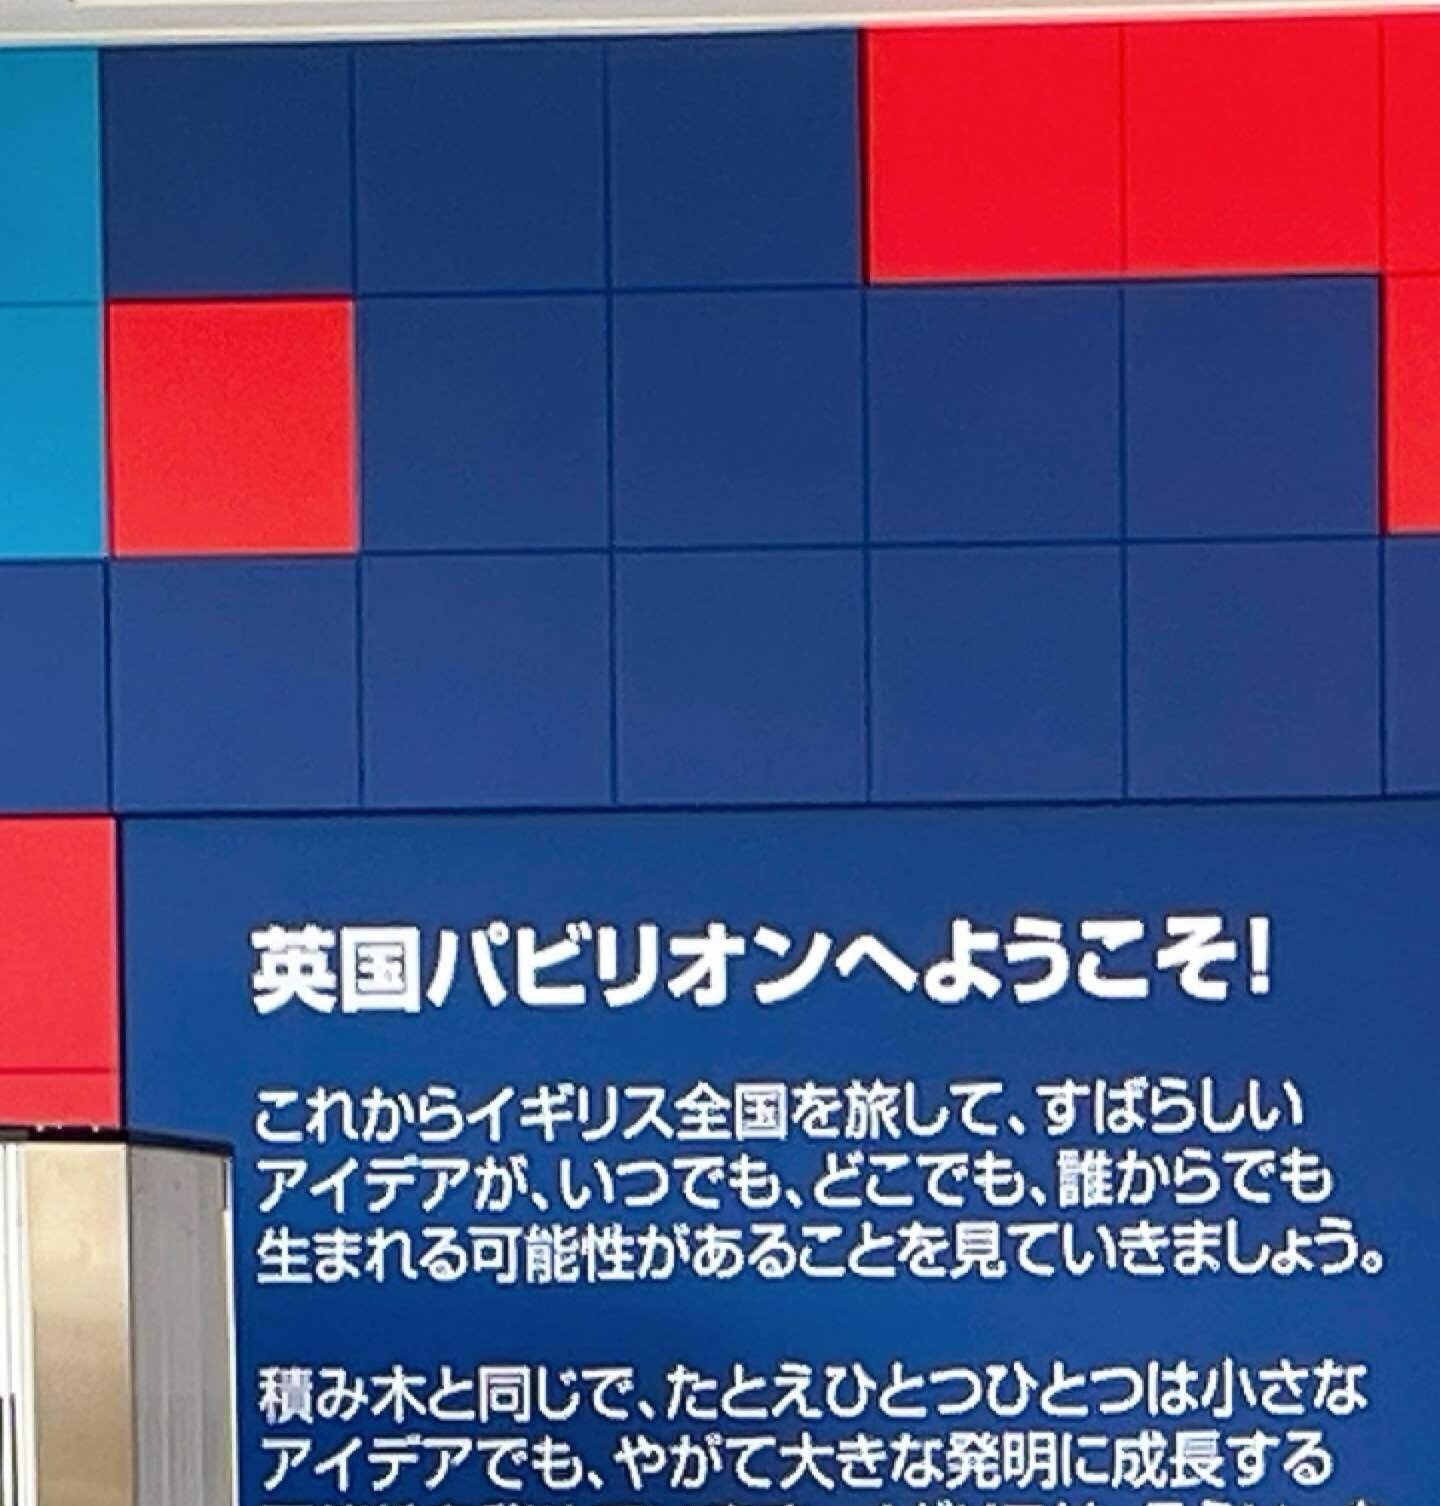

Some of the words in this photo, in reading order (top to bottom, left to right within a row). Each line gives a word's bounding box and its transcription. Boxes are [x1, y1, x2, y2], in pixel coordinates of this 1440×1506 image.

[256, 1076, 1302, 1142] これからイギリス全国を旅して、すばらしい
[258, 1147, 1332, 1213] アイデアが、いつでも、どこでも、誰からでも
[258, 1217, 1382, 1283] 生まれる可能性があることを見ていきましょう。
[259, 1357, 1366, 1424] 積み木と同じで、たとえひとつひとつは小さな
[262, 1430, 1332, 1491] アイデアでも、やがて大きな発明に成長する
